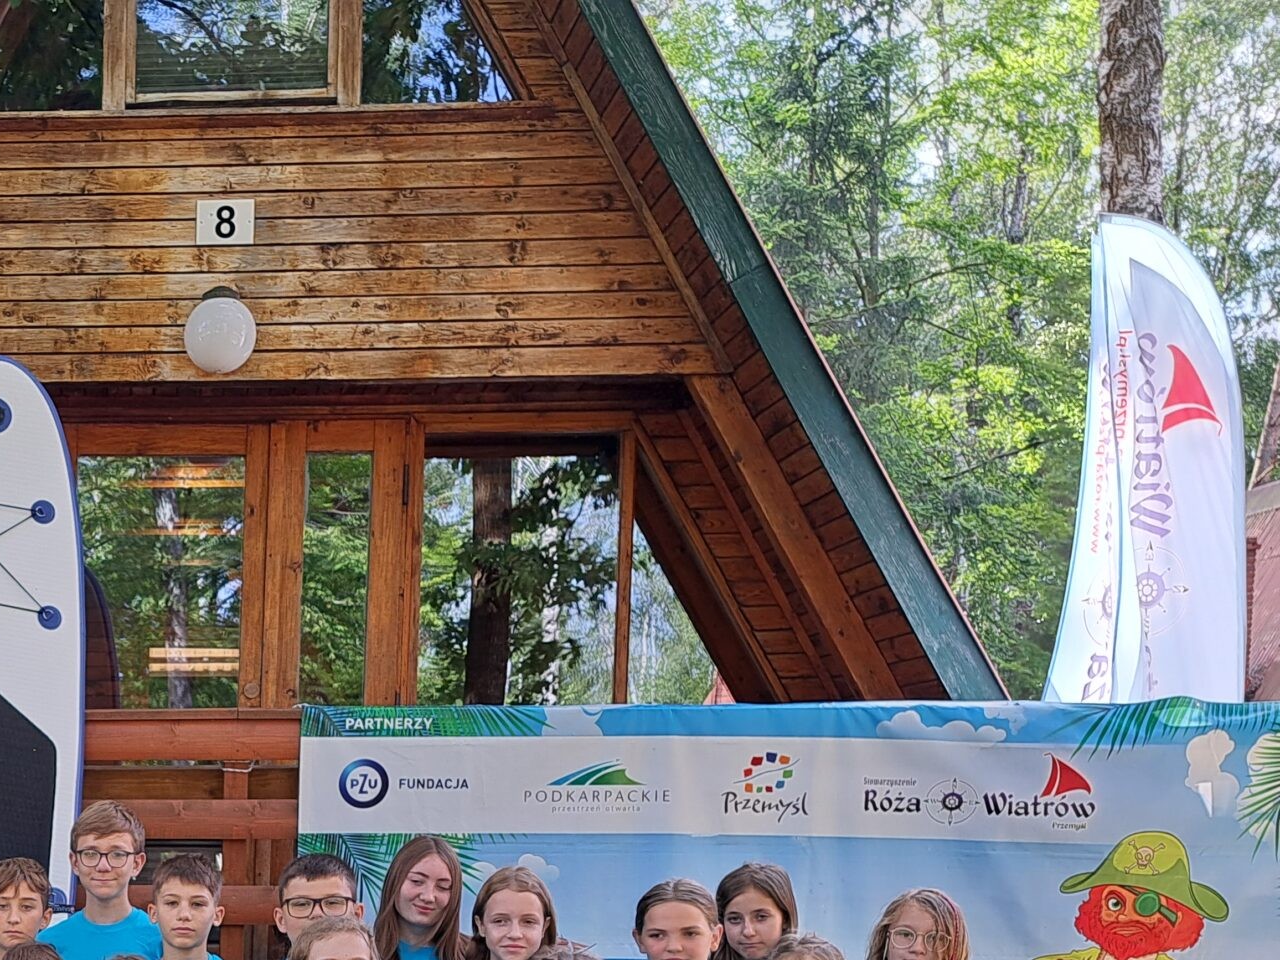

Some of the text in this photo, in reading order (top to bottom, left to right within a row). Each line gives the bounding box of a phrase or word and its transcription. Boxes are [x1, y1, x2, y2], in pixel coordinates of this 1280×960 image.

[214, 205, 236, 239] 8
[345, 717, 433, 731] PARTNERZY
[350, 774, 378, 795] PZU
[398, 778, 469, 790] FUNDACJA
[524, 789, 671, 803] PODKARPACKIE
[864, 788, 920, 814] Róża
[983, 791, 1096, 820] Wiatrów
